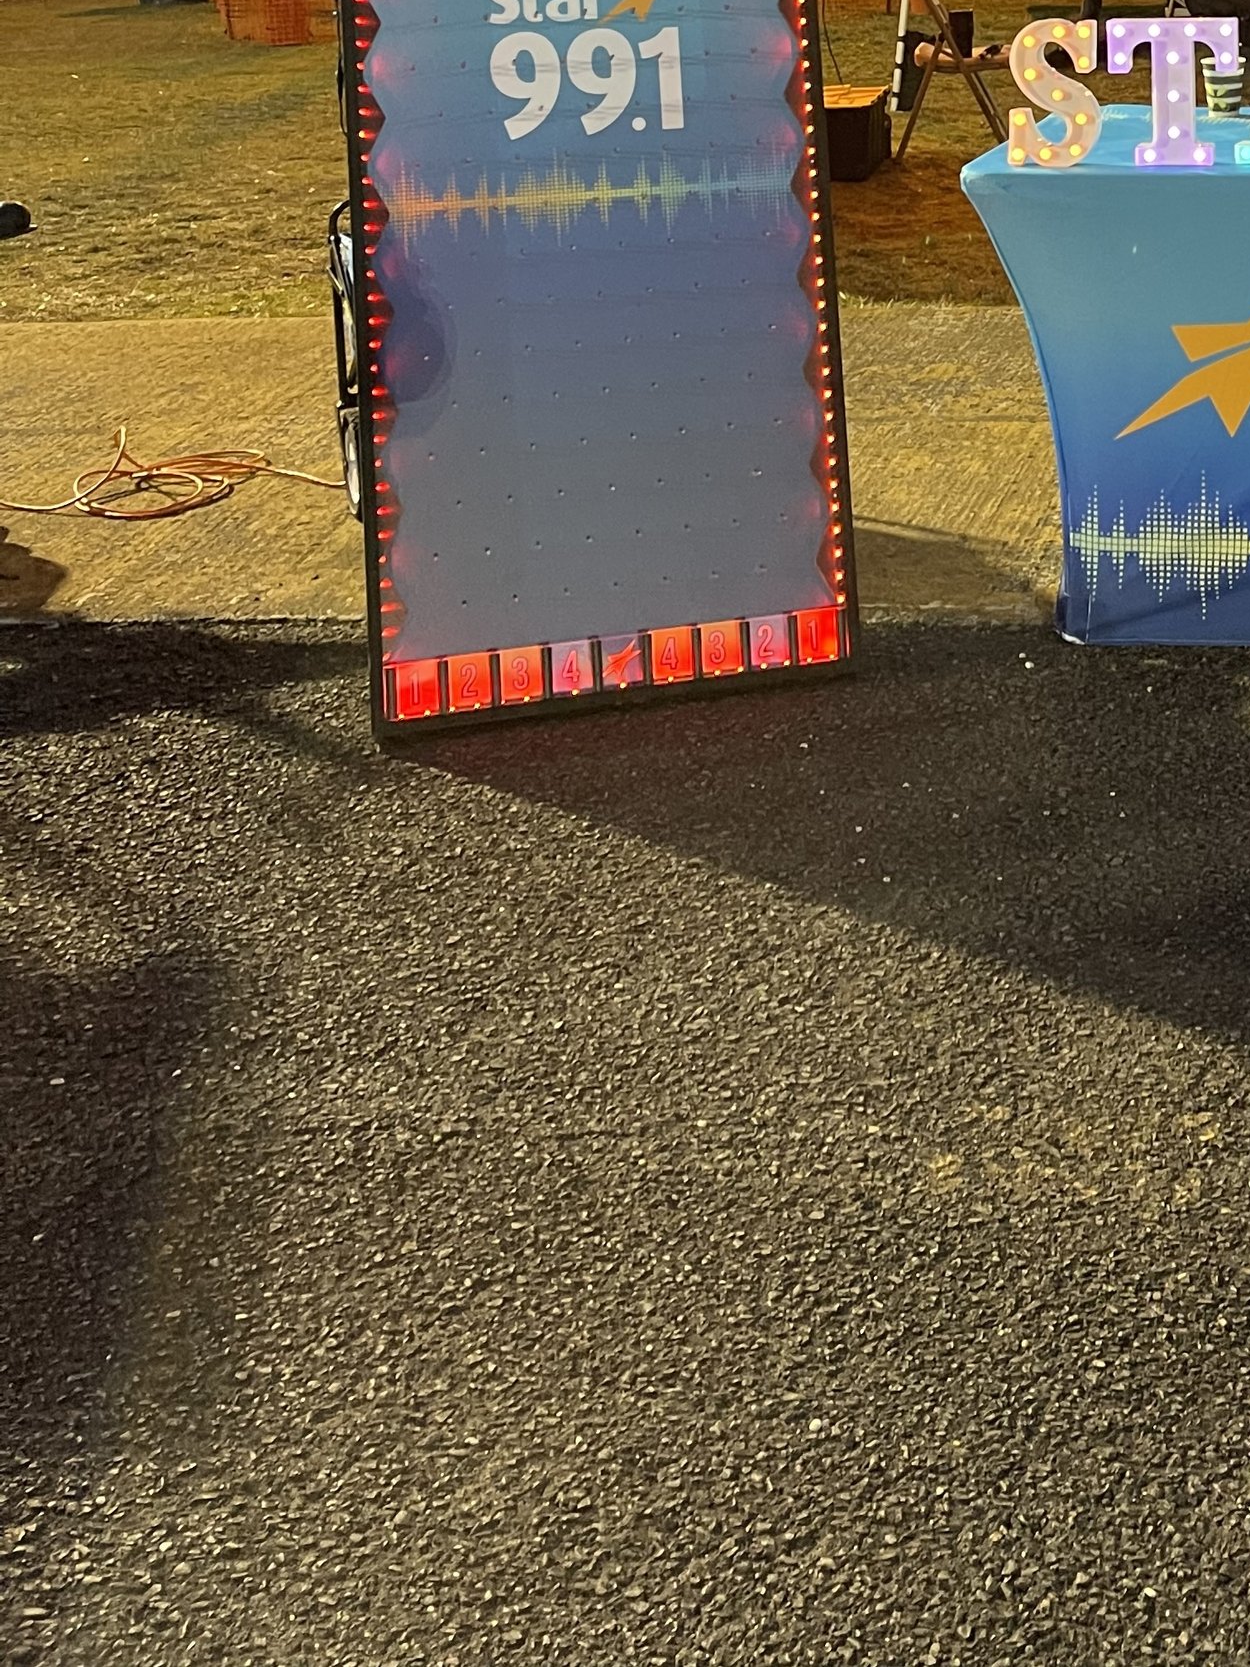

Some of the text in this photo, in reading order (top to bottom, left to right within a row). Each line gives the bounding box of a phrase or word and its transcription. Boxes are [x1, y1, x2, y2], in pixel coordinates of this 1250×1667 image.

[489, 26, 685, 141] 99.1
[408, 618, 819, 706] 1 2 3 4 4 3 2 1
